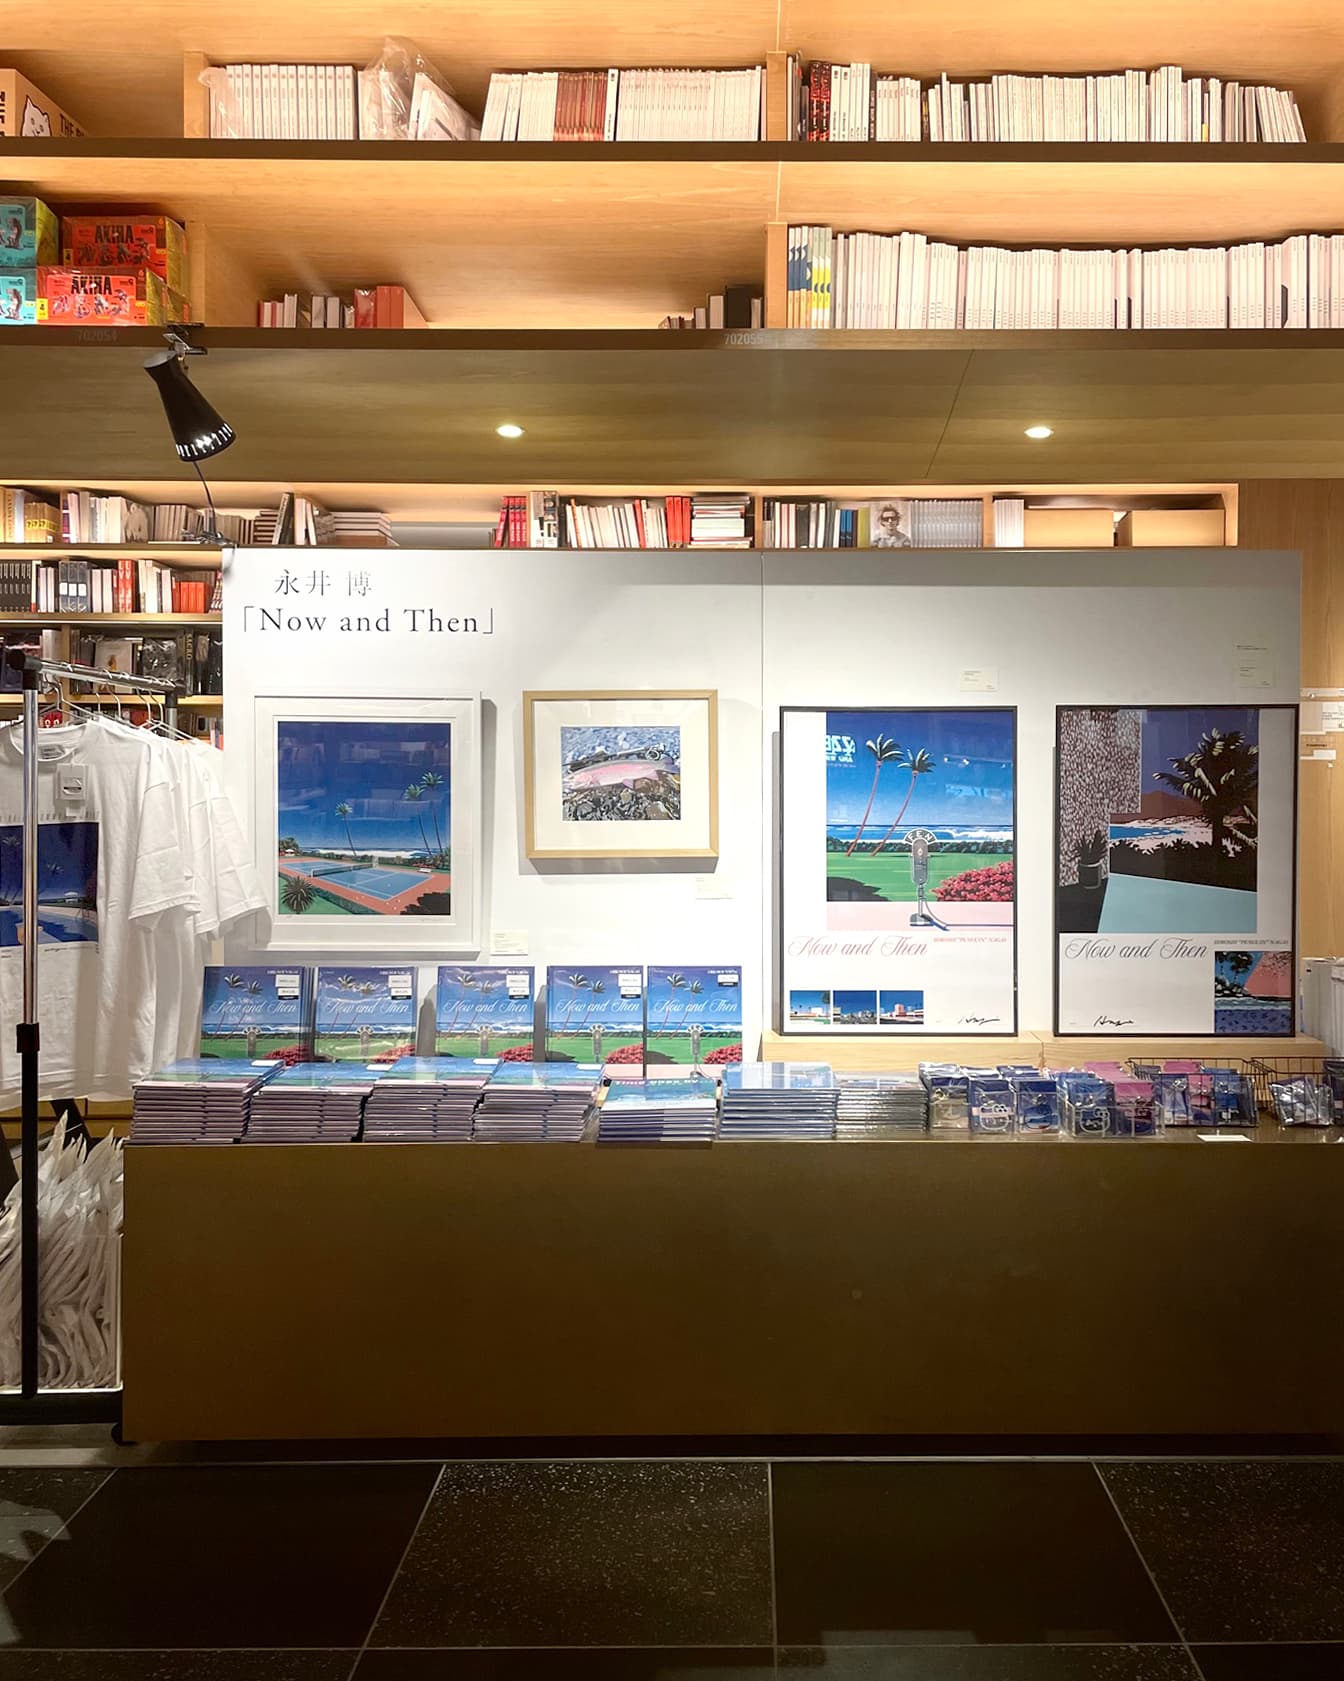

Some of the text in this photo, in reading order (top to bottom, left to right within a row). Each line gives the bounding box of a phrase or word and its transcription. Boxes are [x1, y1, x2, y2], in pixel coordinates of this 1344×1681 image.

[95, 225, 134, 243] AKIRA
[71, 276, 112, 295] AKIRA
[274, 569, 373, 597] 永井 博
[339, 608, 391, 632] and
[908, 830, 932, 841] FEN
[788, 935, 928, 957] Now and Then
[1065, 937, 1208, 960] Now and Then
[211, 1000, 296, 1014] Now and Then
[322, 1000, 409, 1014] Now and Then
[443, 999, 529, 1013] Now and Then
[555, 999, 640, 1013] Now and Then
[654, 999, 738, 1013] Now and Then
